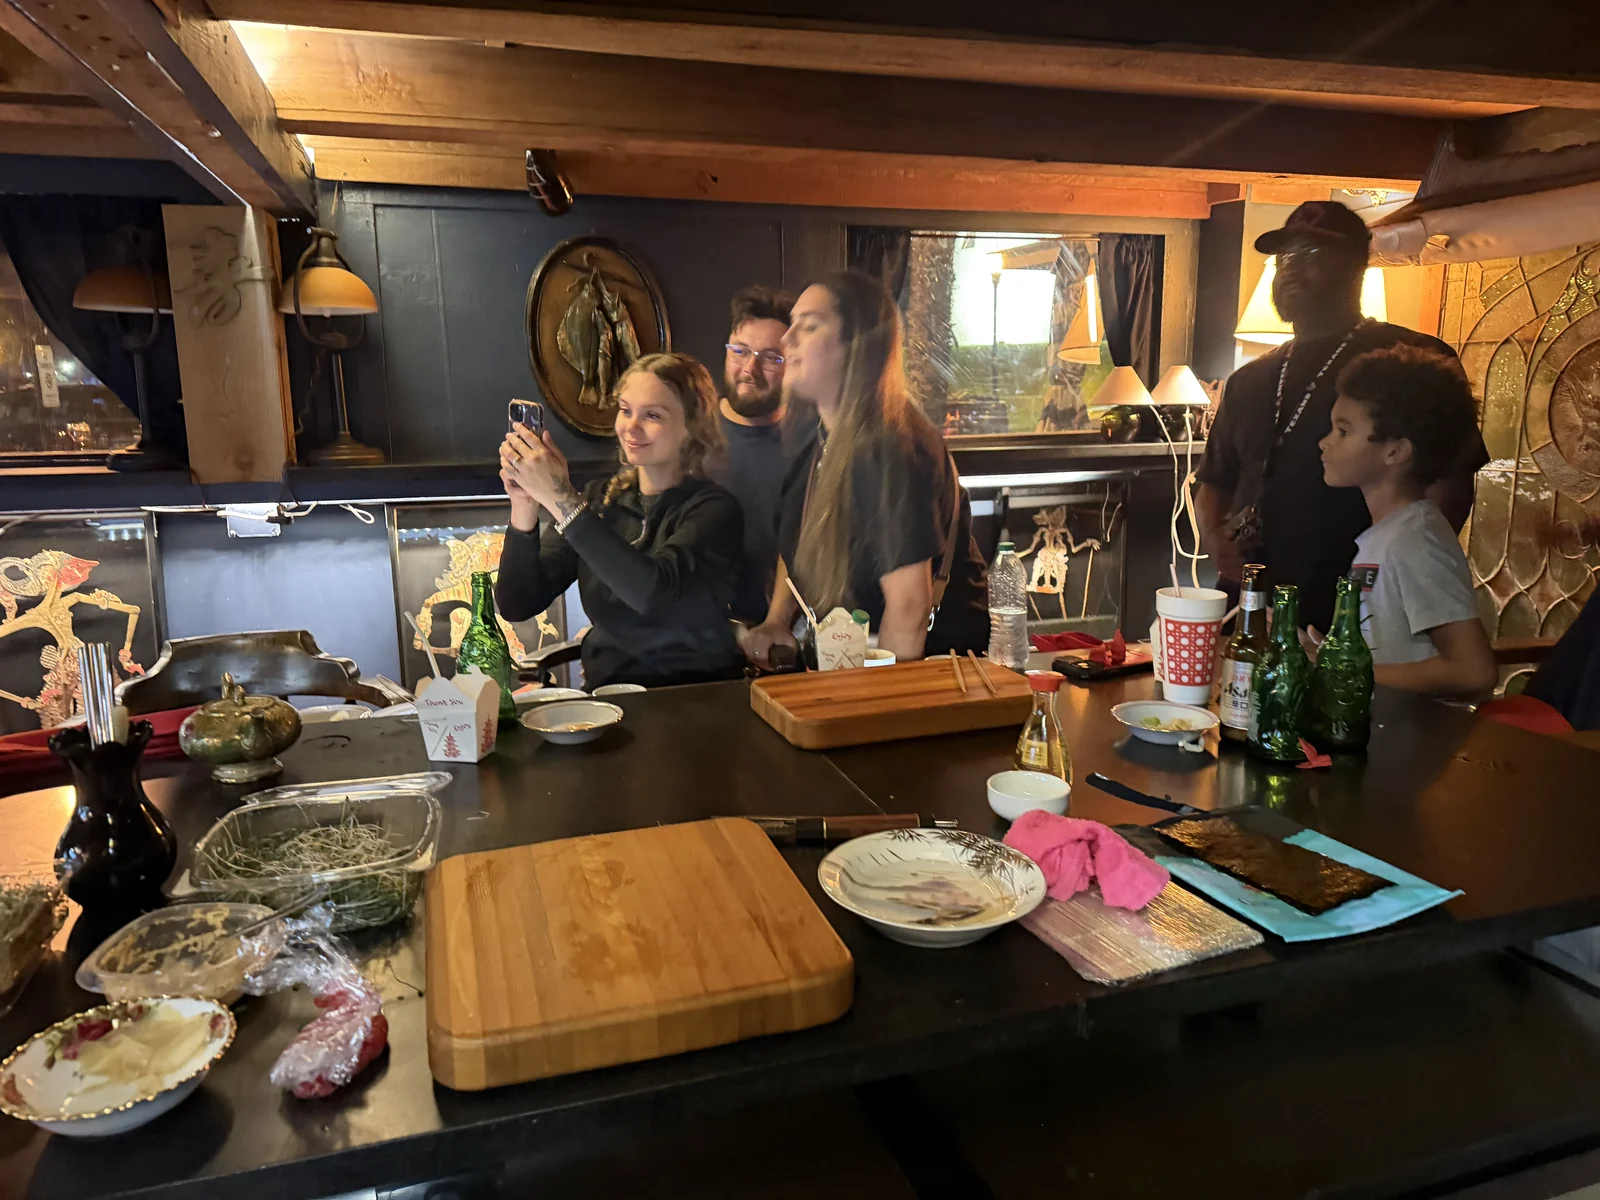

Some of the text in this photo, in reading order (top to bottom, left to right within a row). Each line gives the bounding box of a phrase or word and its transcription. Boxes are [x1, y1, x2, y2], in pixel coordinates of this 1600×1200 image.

[1317, 342, 1348, 378] TEXANS
[1284, 393, 1311, 433] TEXANS
[832, 632, 852, 641] Enjoy
[424, 698, 448, 707] Thank
[454, 723, 471, 731] Enjoy
